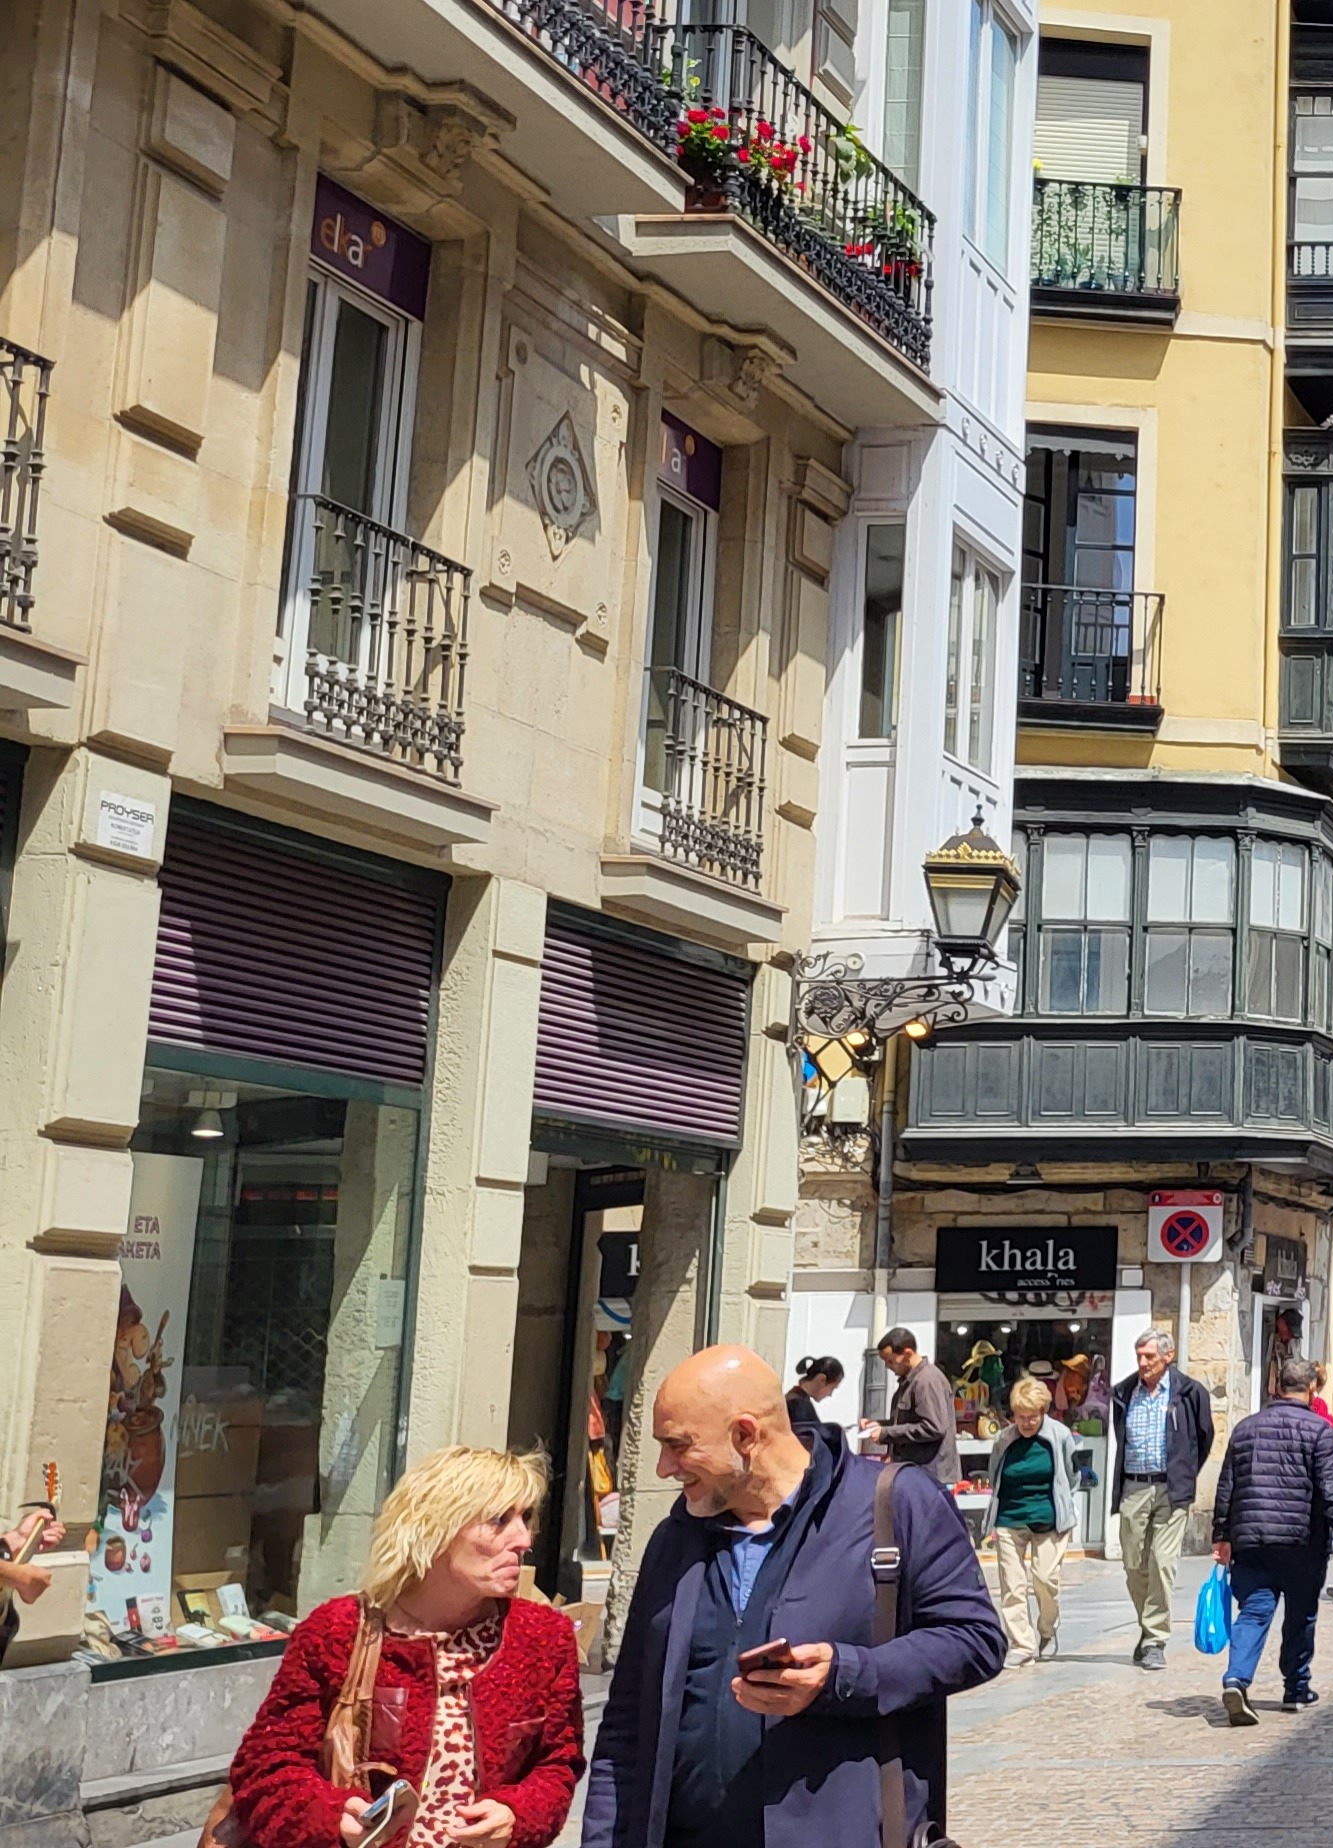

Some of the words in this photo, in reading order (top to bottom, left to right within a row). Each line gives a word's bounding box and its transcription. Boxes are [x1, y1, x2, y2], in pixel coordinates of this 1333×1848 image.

[100, 800, 154, 825] PROYSER
[134, 1215, 161, 1235] ETA
[978, 1239, 1077, 1272] khala
